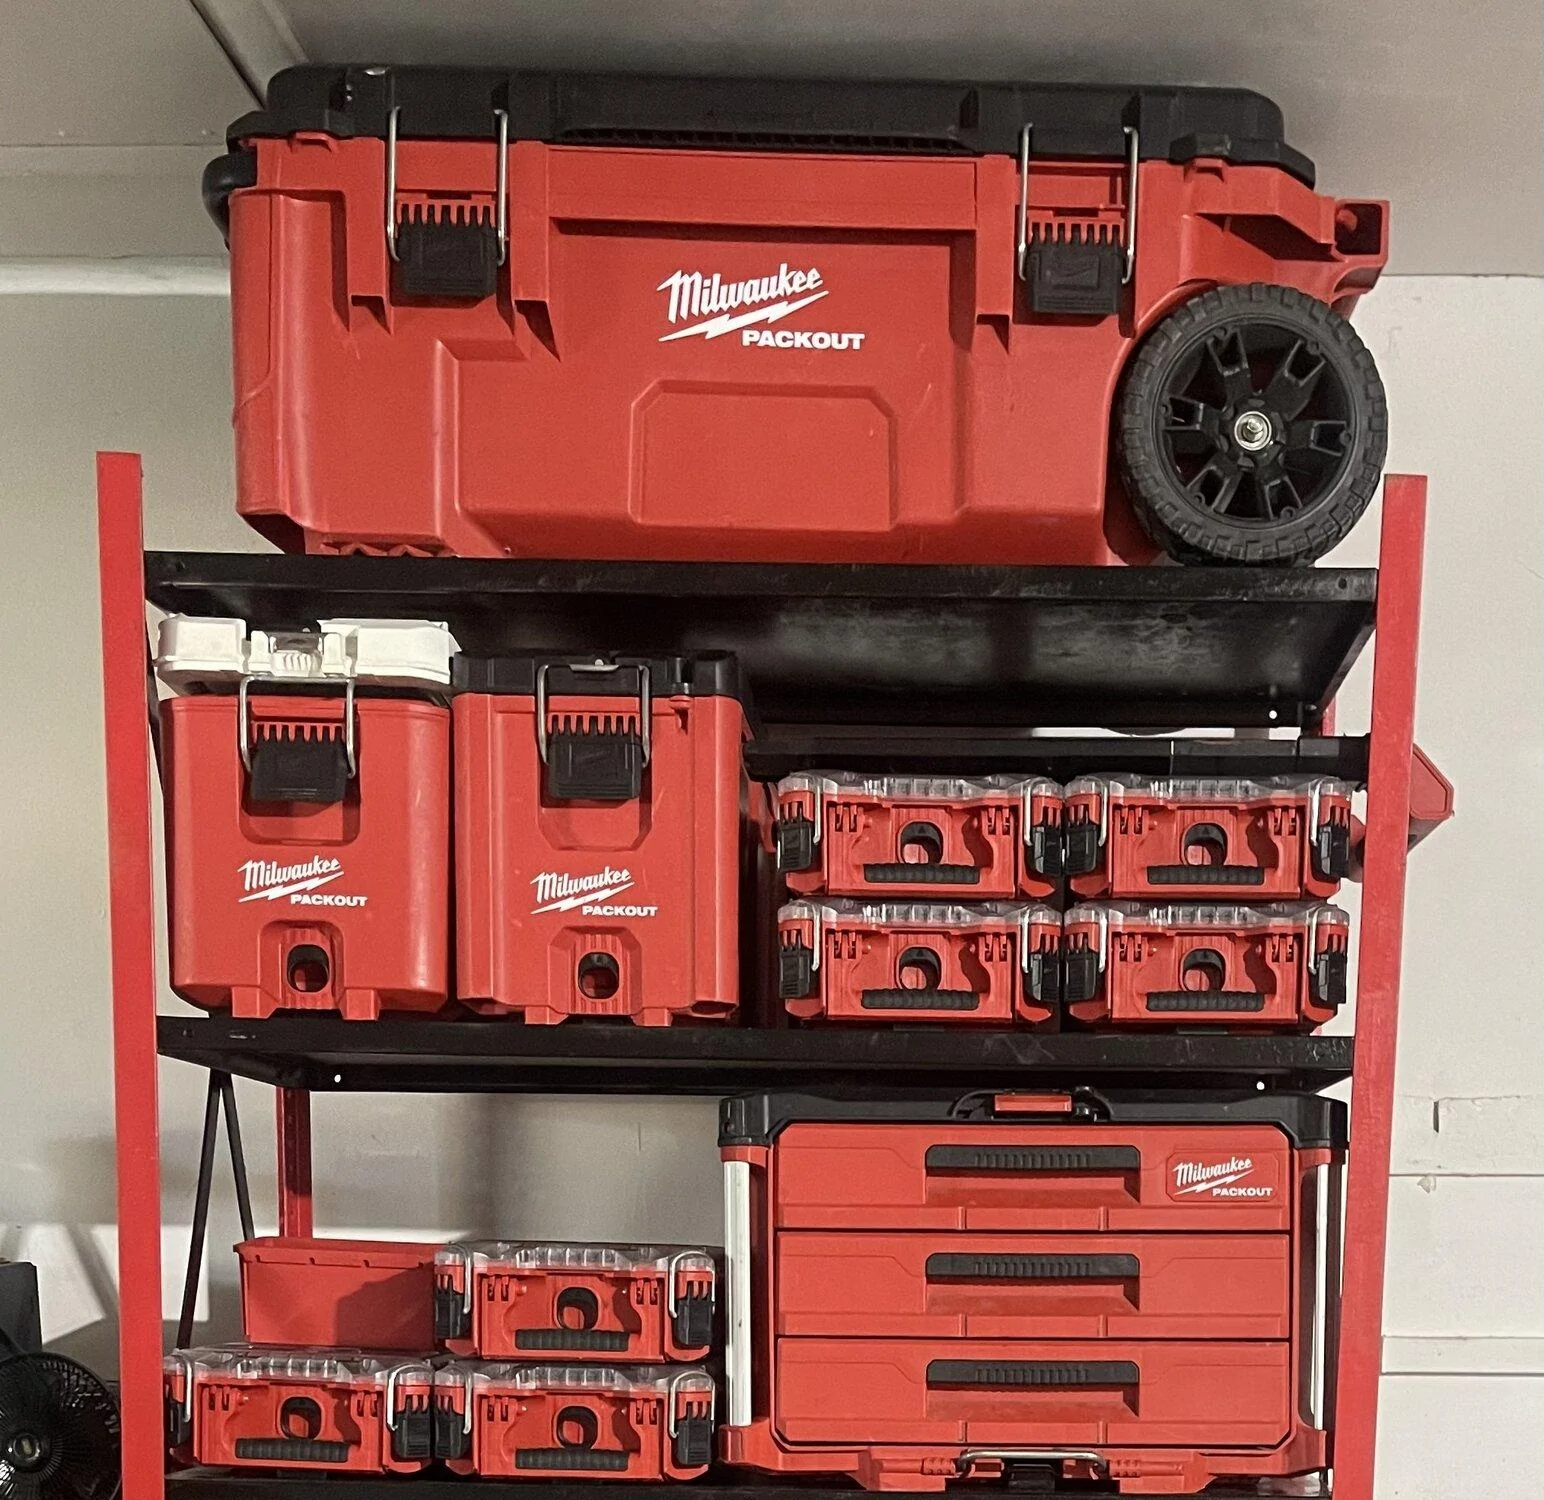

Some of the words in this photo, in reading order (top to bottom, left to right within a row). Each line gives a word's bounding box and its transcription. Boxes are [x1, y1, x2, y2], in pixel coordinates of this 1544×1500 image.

[656, 262, 824, 323] Milwaukee
[741, 329, 866, 350] PACKOUT
[237, 854, 342, 892] Milwaukee
[529, 865, 632, 903] Milwaukee
[290, 893, 368, 908] PACKOUT
[581, 905, 659, 917] PACKOUT
[1173, 1156, 1253, 1187] Milwaukee
[1212, 1186, 1273, 1198] PACKOUT
